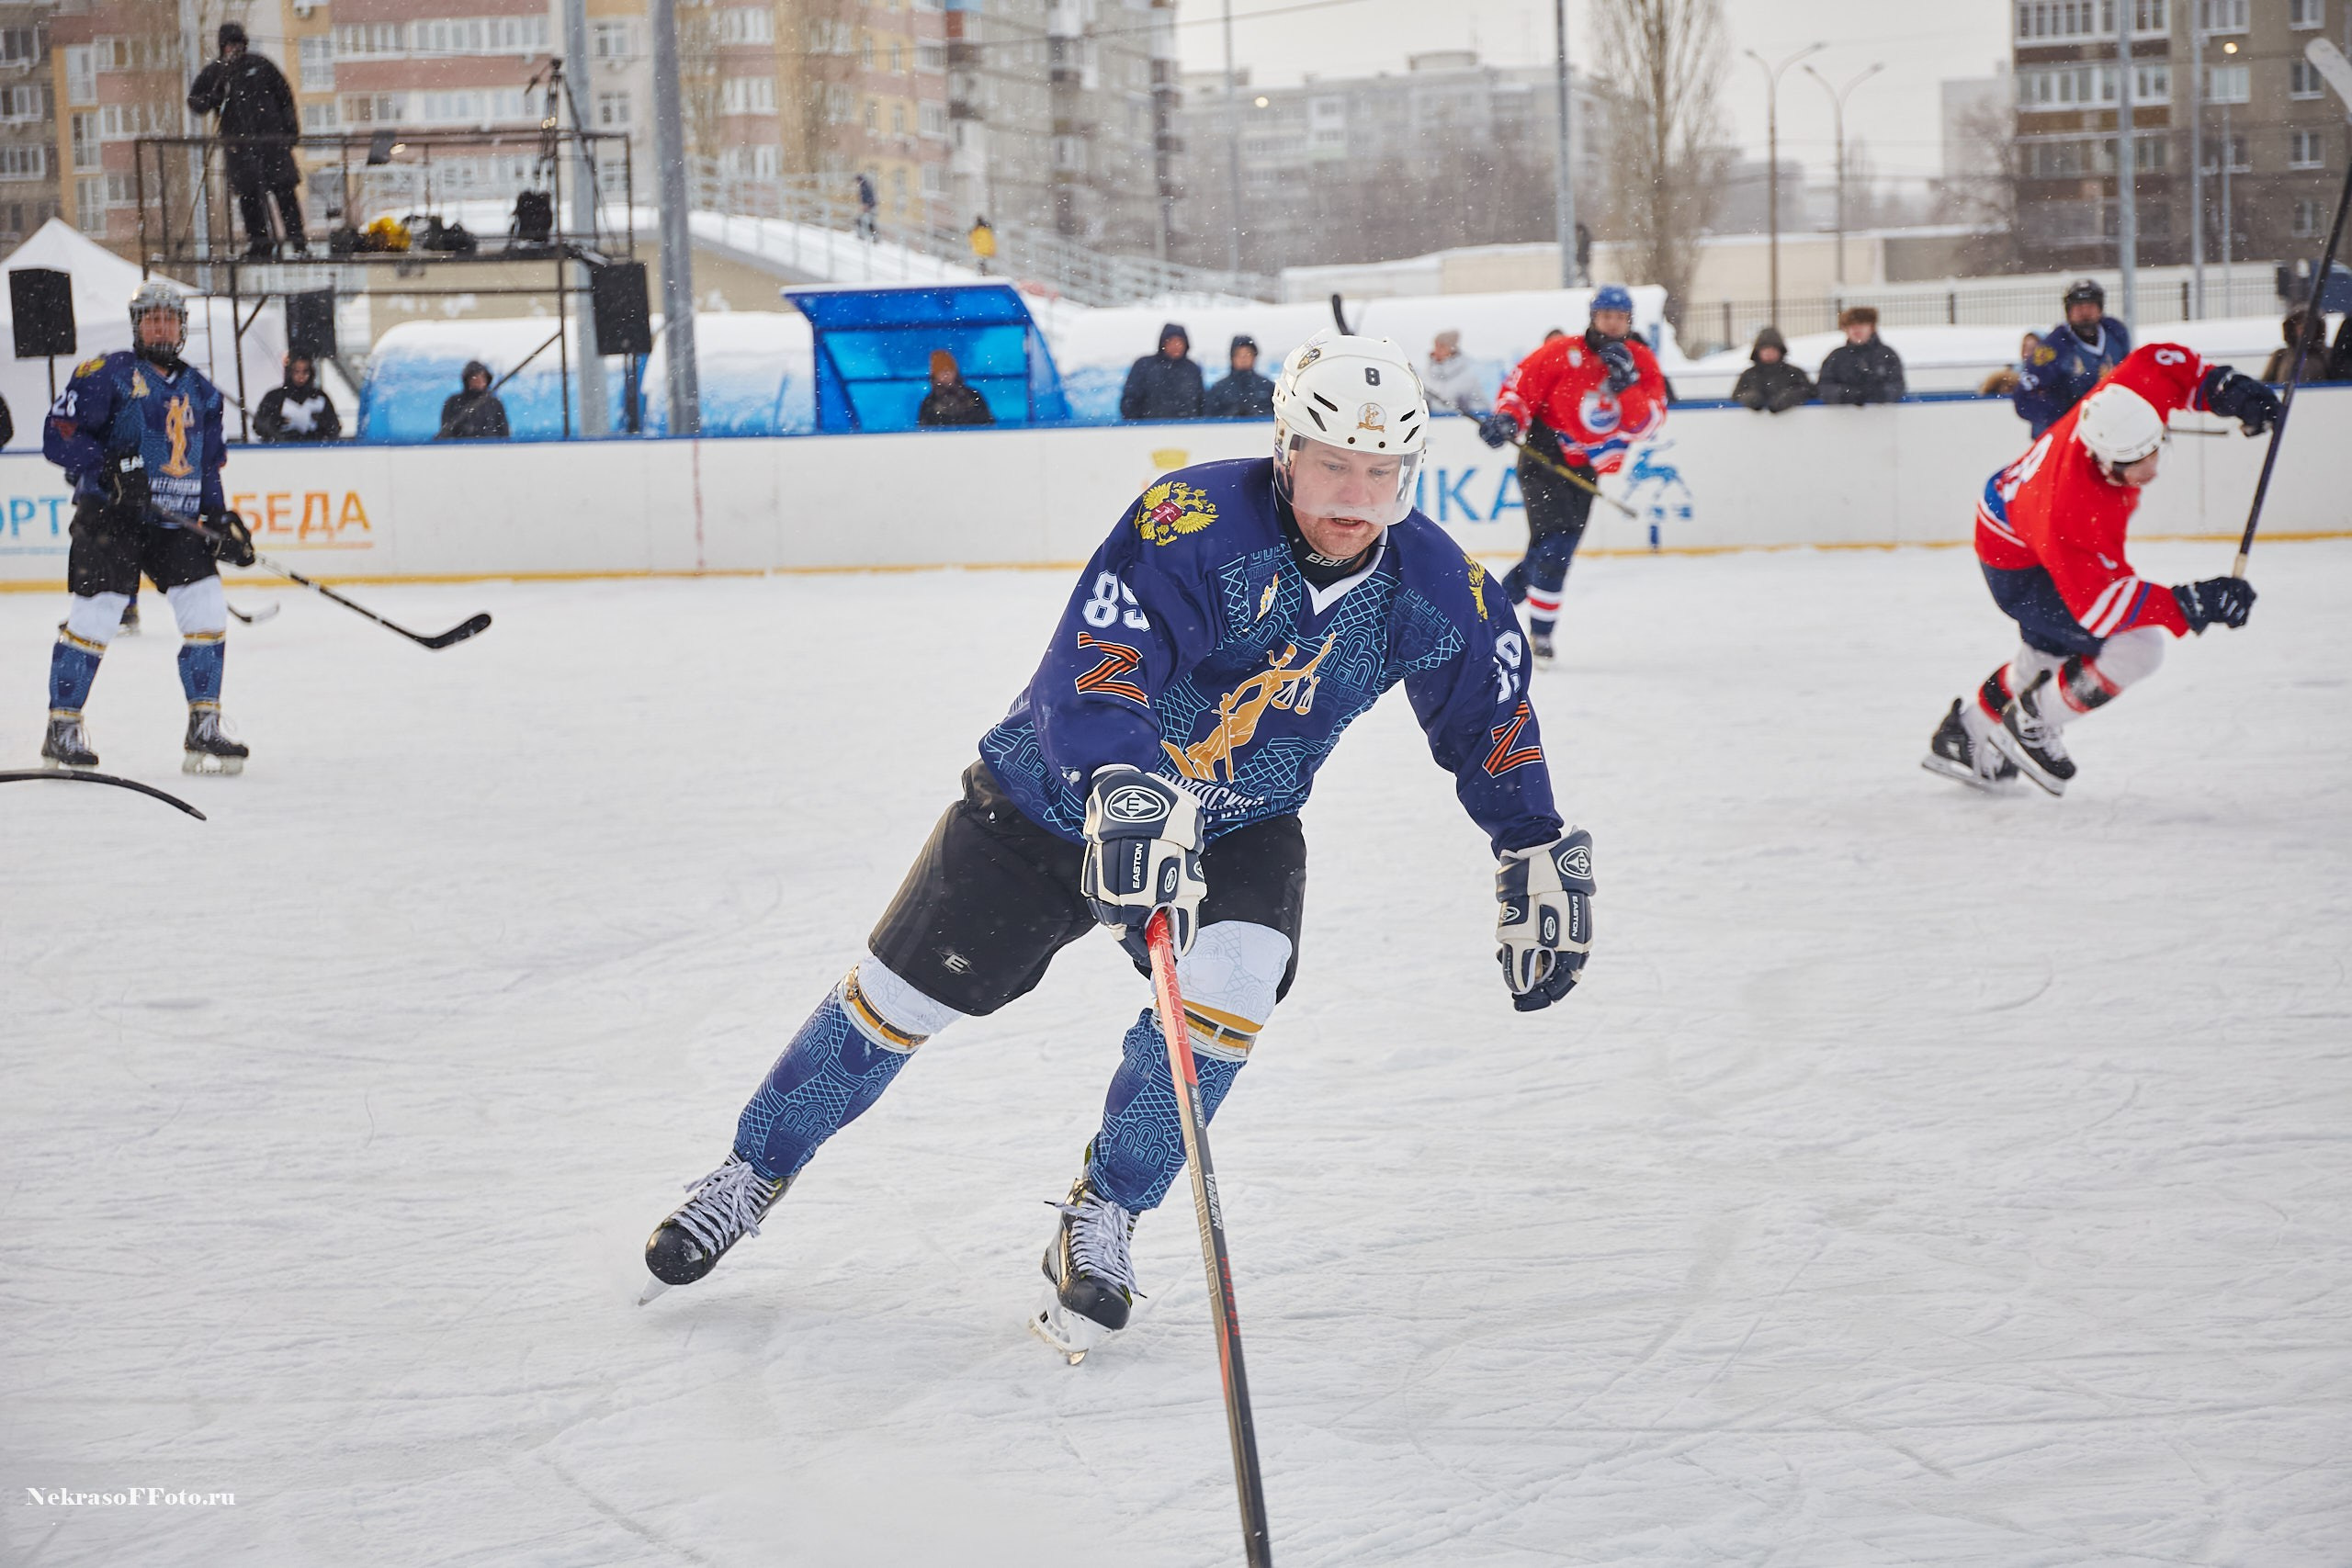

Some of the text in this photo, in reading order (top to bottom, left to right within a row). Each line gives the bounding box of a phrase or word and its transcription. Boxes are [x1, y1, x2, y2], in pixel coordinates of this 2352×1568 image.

[1364, 367, 1381, 386] 8
[52, 389, 79, 416] 28
[232, 491, 372, 542] БЕДА
[1132, 843, 1145, 889] EASTON
[1571, 896, 1579, 937] EASTON
